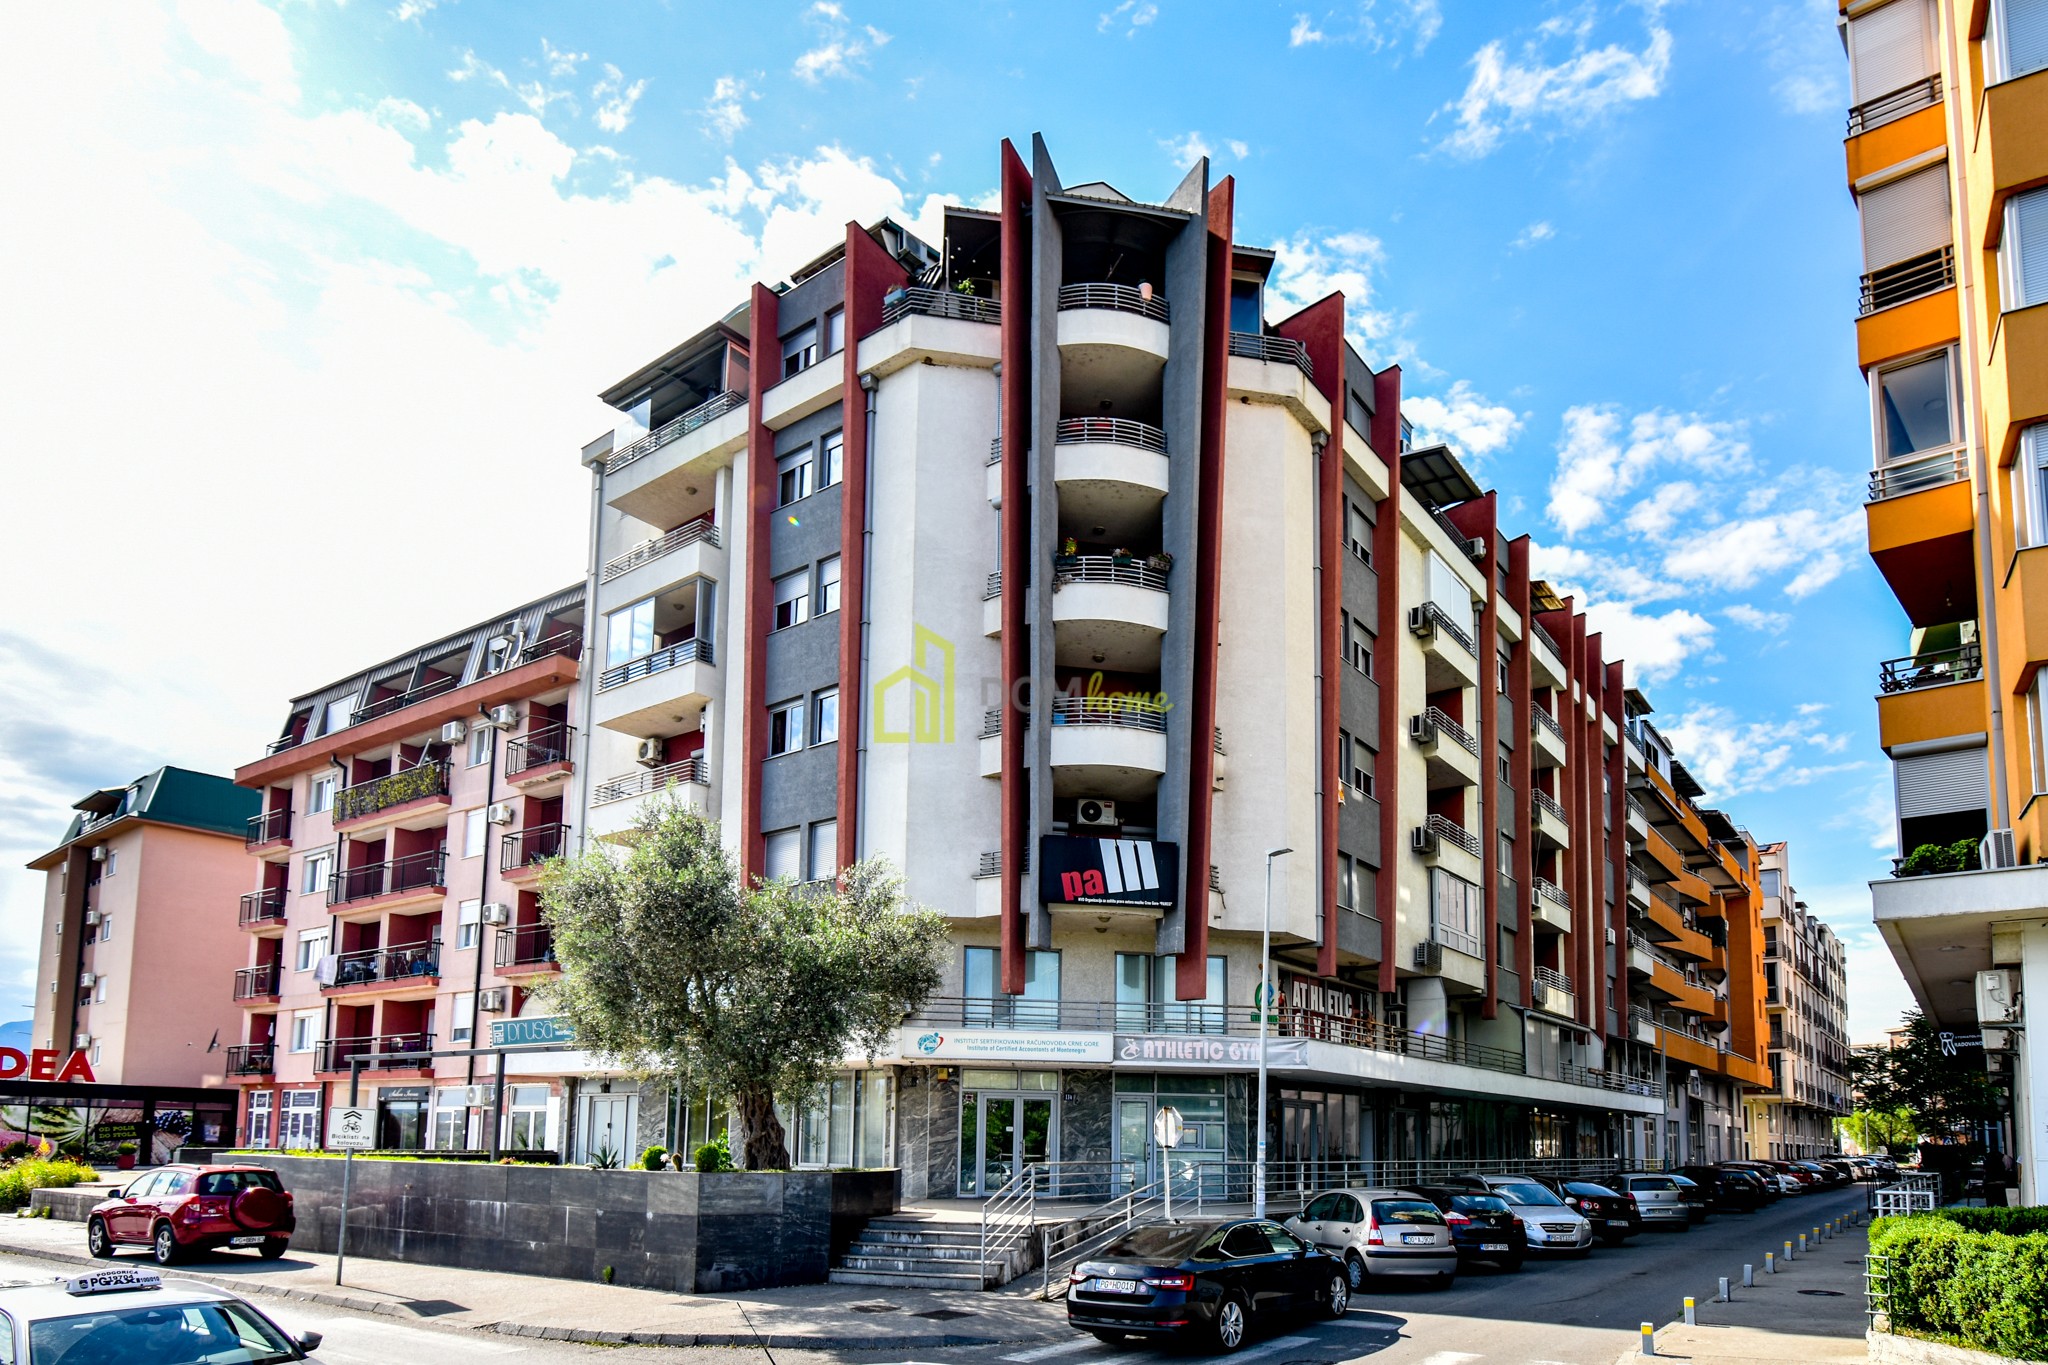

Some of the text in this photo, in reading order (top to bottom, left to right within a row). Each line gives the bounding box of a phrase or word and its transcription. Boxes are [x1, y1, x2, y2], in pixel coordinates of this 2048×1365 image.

[1292, 981, 1353, 1019] ATHLETIC
[507, 1020, 553, 1042] prusa
[1144, 1040, 1224, 1060] ATHLETIC
